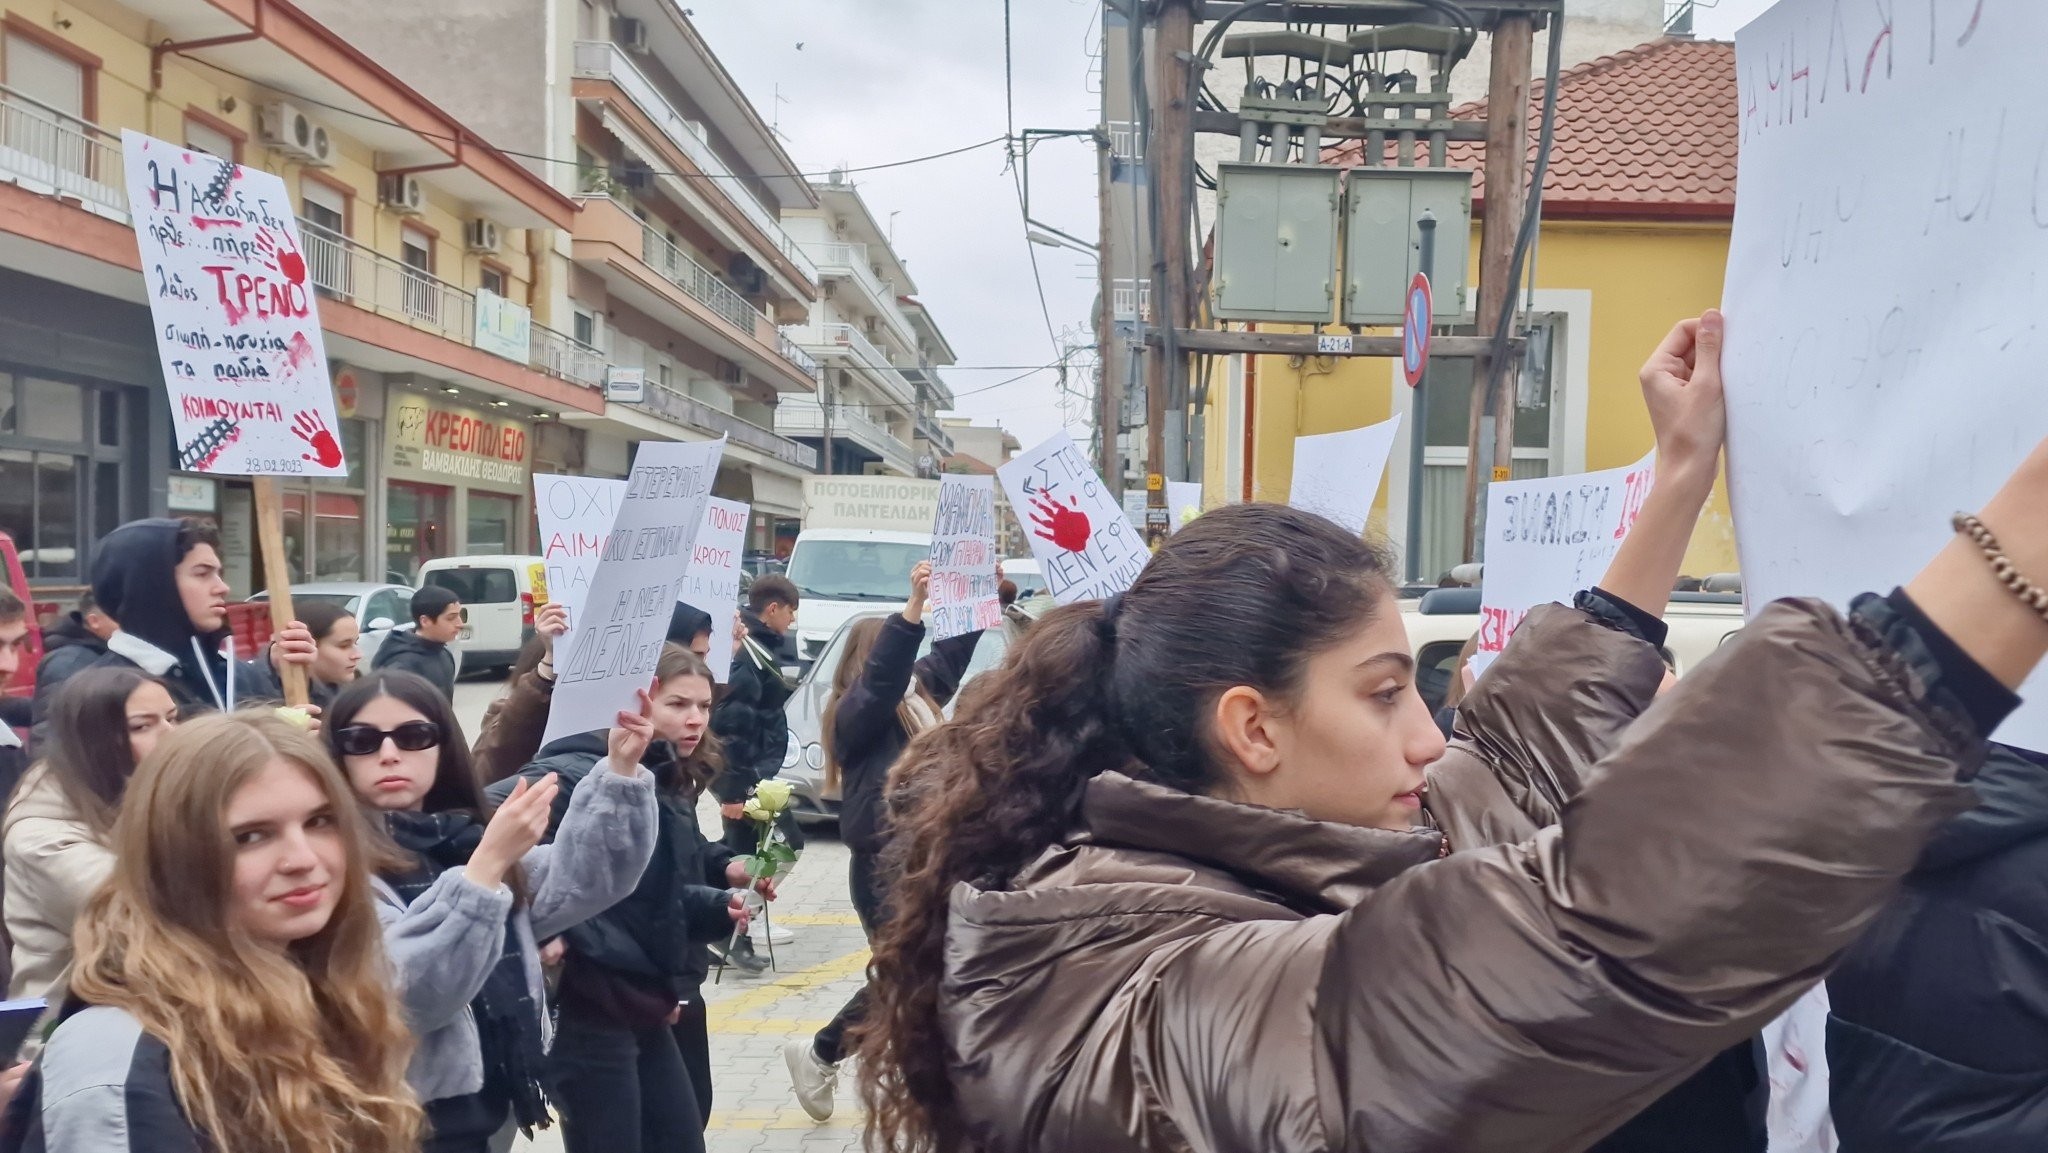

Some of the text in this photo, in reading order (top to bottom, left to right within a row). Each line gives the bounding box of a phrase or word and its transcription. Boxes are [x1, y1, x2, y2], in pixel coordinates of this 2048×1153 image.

[148, 159, 180, 213] Η
[201, 265, 310, 320] ΤΡΕΝΟ
[172, 360, 196, 377] τα
[180, 393, 283, 423] ΚΟΙΜΟΥΝΤΑΙ
[425, 409, 526, 462] ΚΡΕΟΠΩΛΕΙΟ
[422, 450, 481, 479] ΒΑΜΒΑΚΙΔΗΣ
[481, 461, 523, 485] ΘΕΟΔΩΡΟΣ
[548, 480, 746, 532] ΟΧΙ ΠΟΝΟΣ
[546, 532, 731, 568] ΑΙΜ ΚΡΟΥΣ
[710, 579, 738, 602] ΜΑΣ
[560, 621, 645, 684] ΔΕΝ
